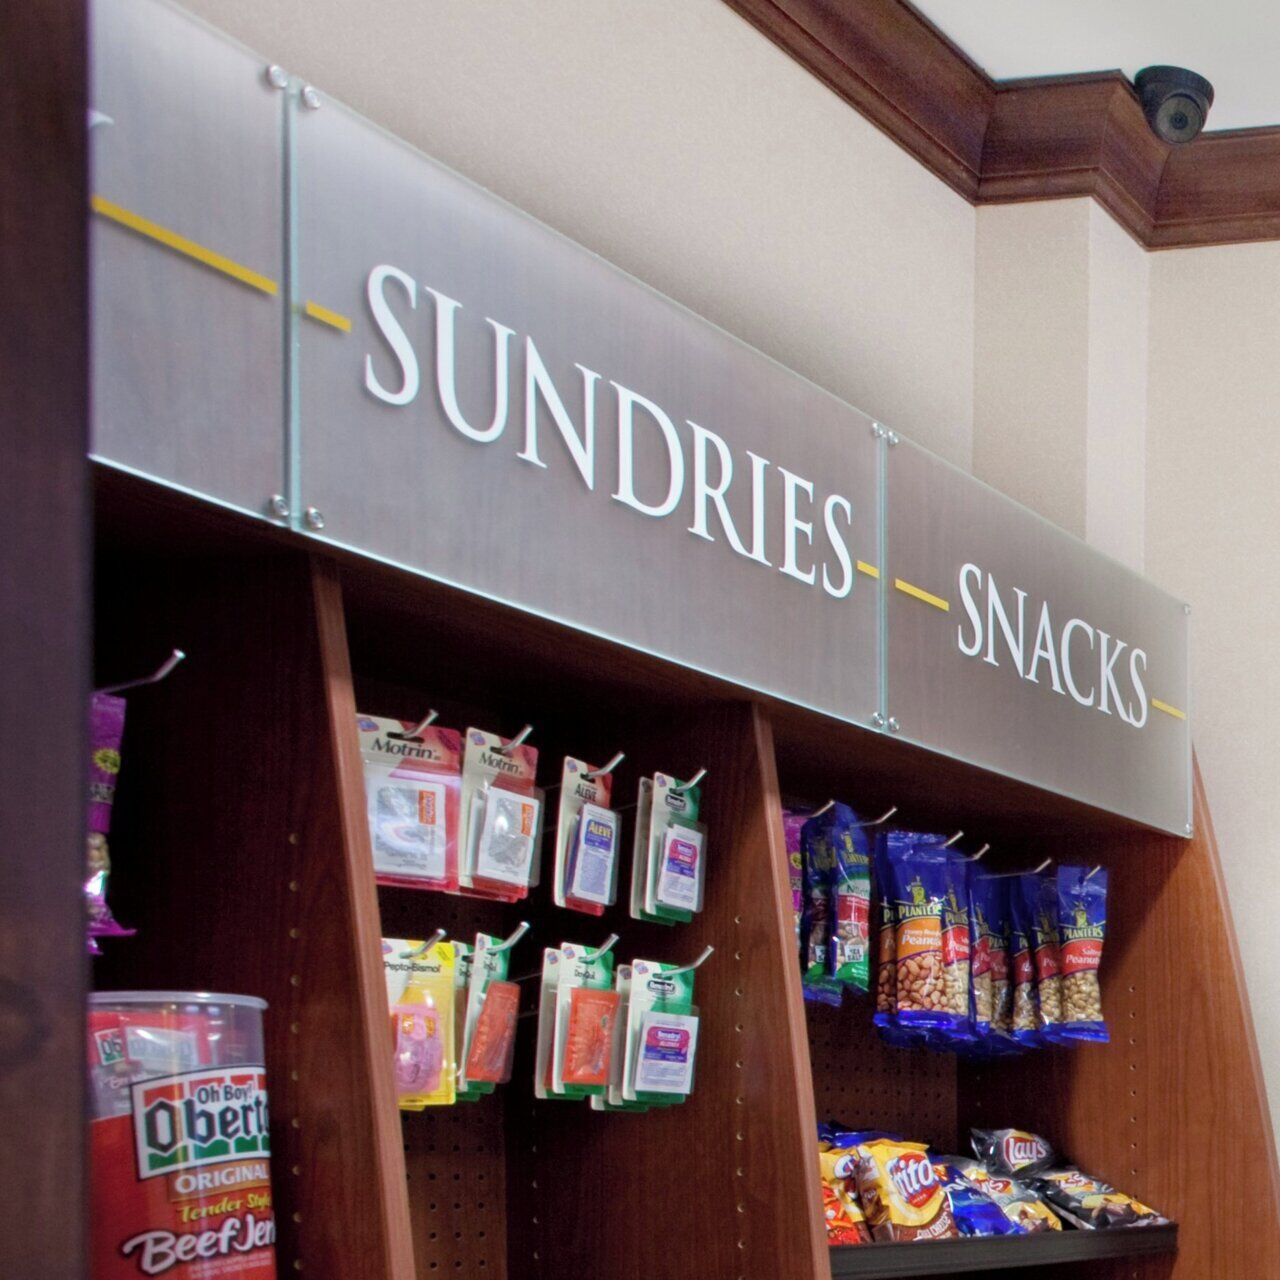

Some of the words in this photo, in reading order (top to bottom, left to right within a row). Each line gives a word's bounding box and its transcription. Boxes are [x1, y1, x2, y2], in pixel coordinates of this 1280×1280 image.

[365, 264, 854, 600] SUNDRIES
[957, 562, 1148, 729] SNACKS
[371, 737, 433, 760] Motrin
[479, 752, 520, 775] Motrin
[197, 1085, 221, 1105] Oh
[223, 1080, 253, 1100] Boy!
[175, 1162, 268, 1194] ORIGINAL
[180, 1197, 243, 1223] Tender
[122, 1216, 240, 1275] Beef
